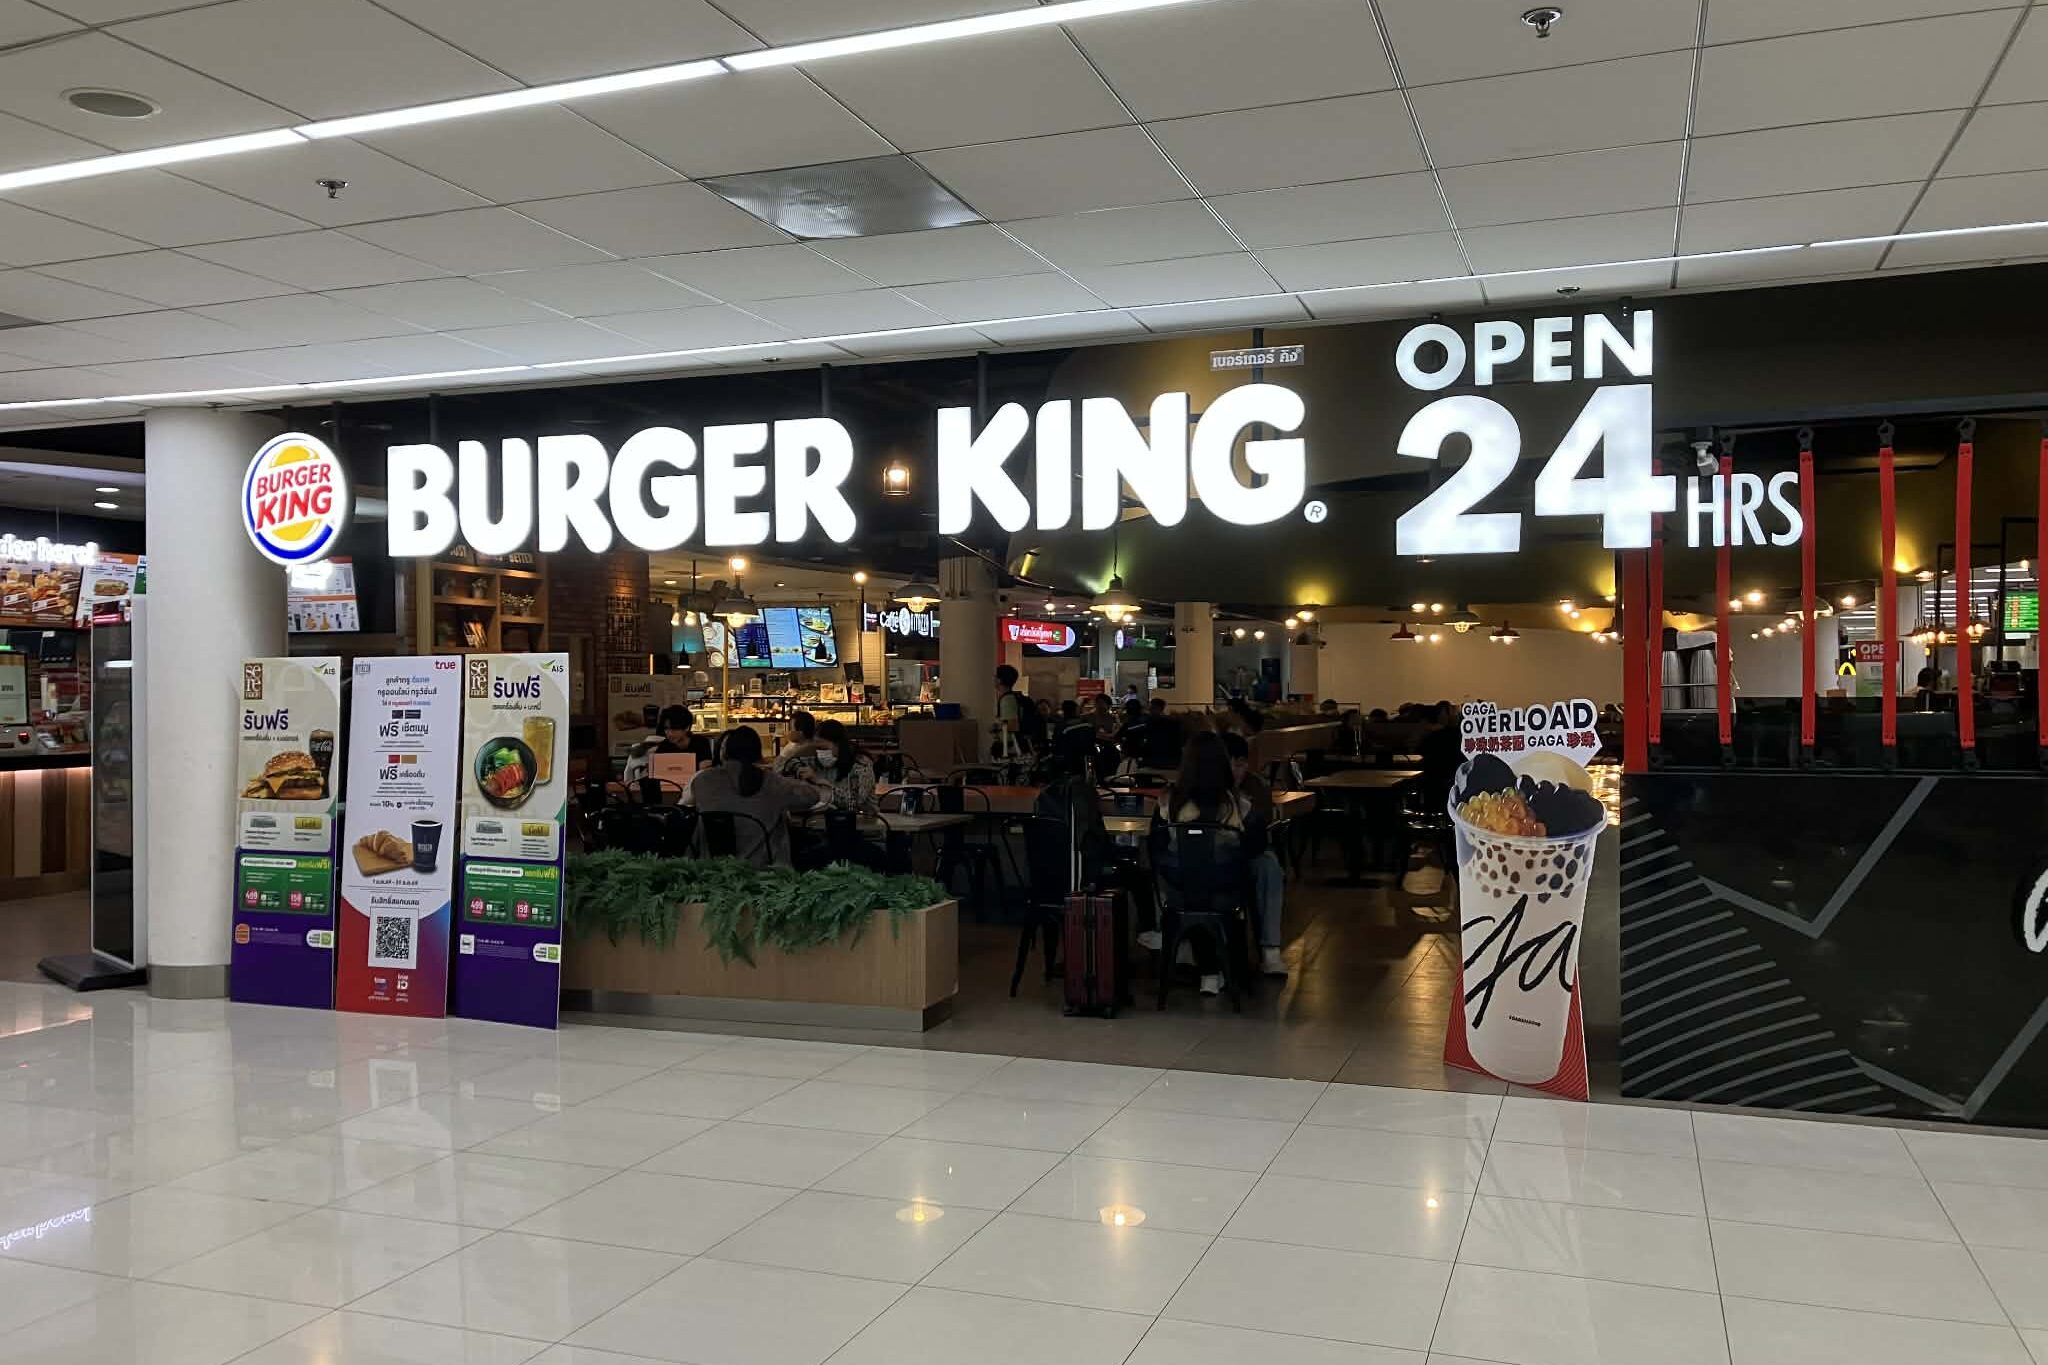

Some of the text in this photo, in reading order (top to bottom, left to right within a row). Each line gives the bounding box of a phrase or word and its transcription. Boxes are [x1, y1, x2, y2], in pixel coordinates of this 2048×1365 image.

[1396, 309, 1653, 391] OPEN
[387, 417, 856, 558] BURGER
[937, 383, 1306, 535] KING
[1396, 384, 1803, 555] 24 HRS
[255, 463, 331, 499] BURGER
[255, 485, 333, 530] KING
[435, 660, 456, 670] true
[551, 665, 564, 673] AIS
[493, 675, 541, 698] รับฟรี
[244, 708, 288, 730] รับฟรี
[1463, 702, 1594, 734] OVERLOAD
[1464, 704, 1496, 716] GAGA
[379, 720, 399, 737] ฟรี
[1527, 735, 1565, 747] GAGA
[379, 765, 398, 780] ฟรี
